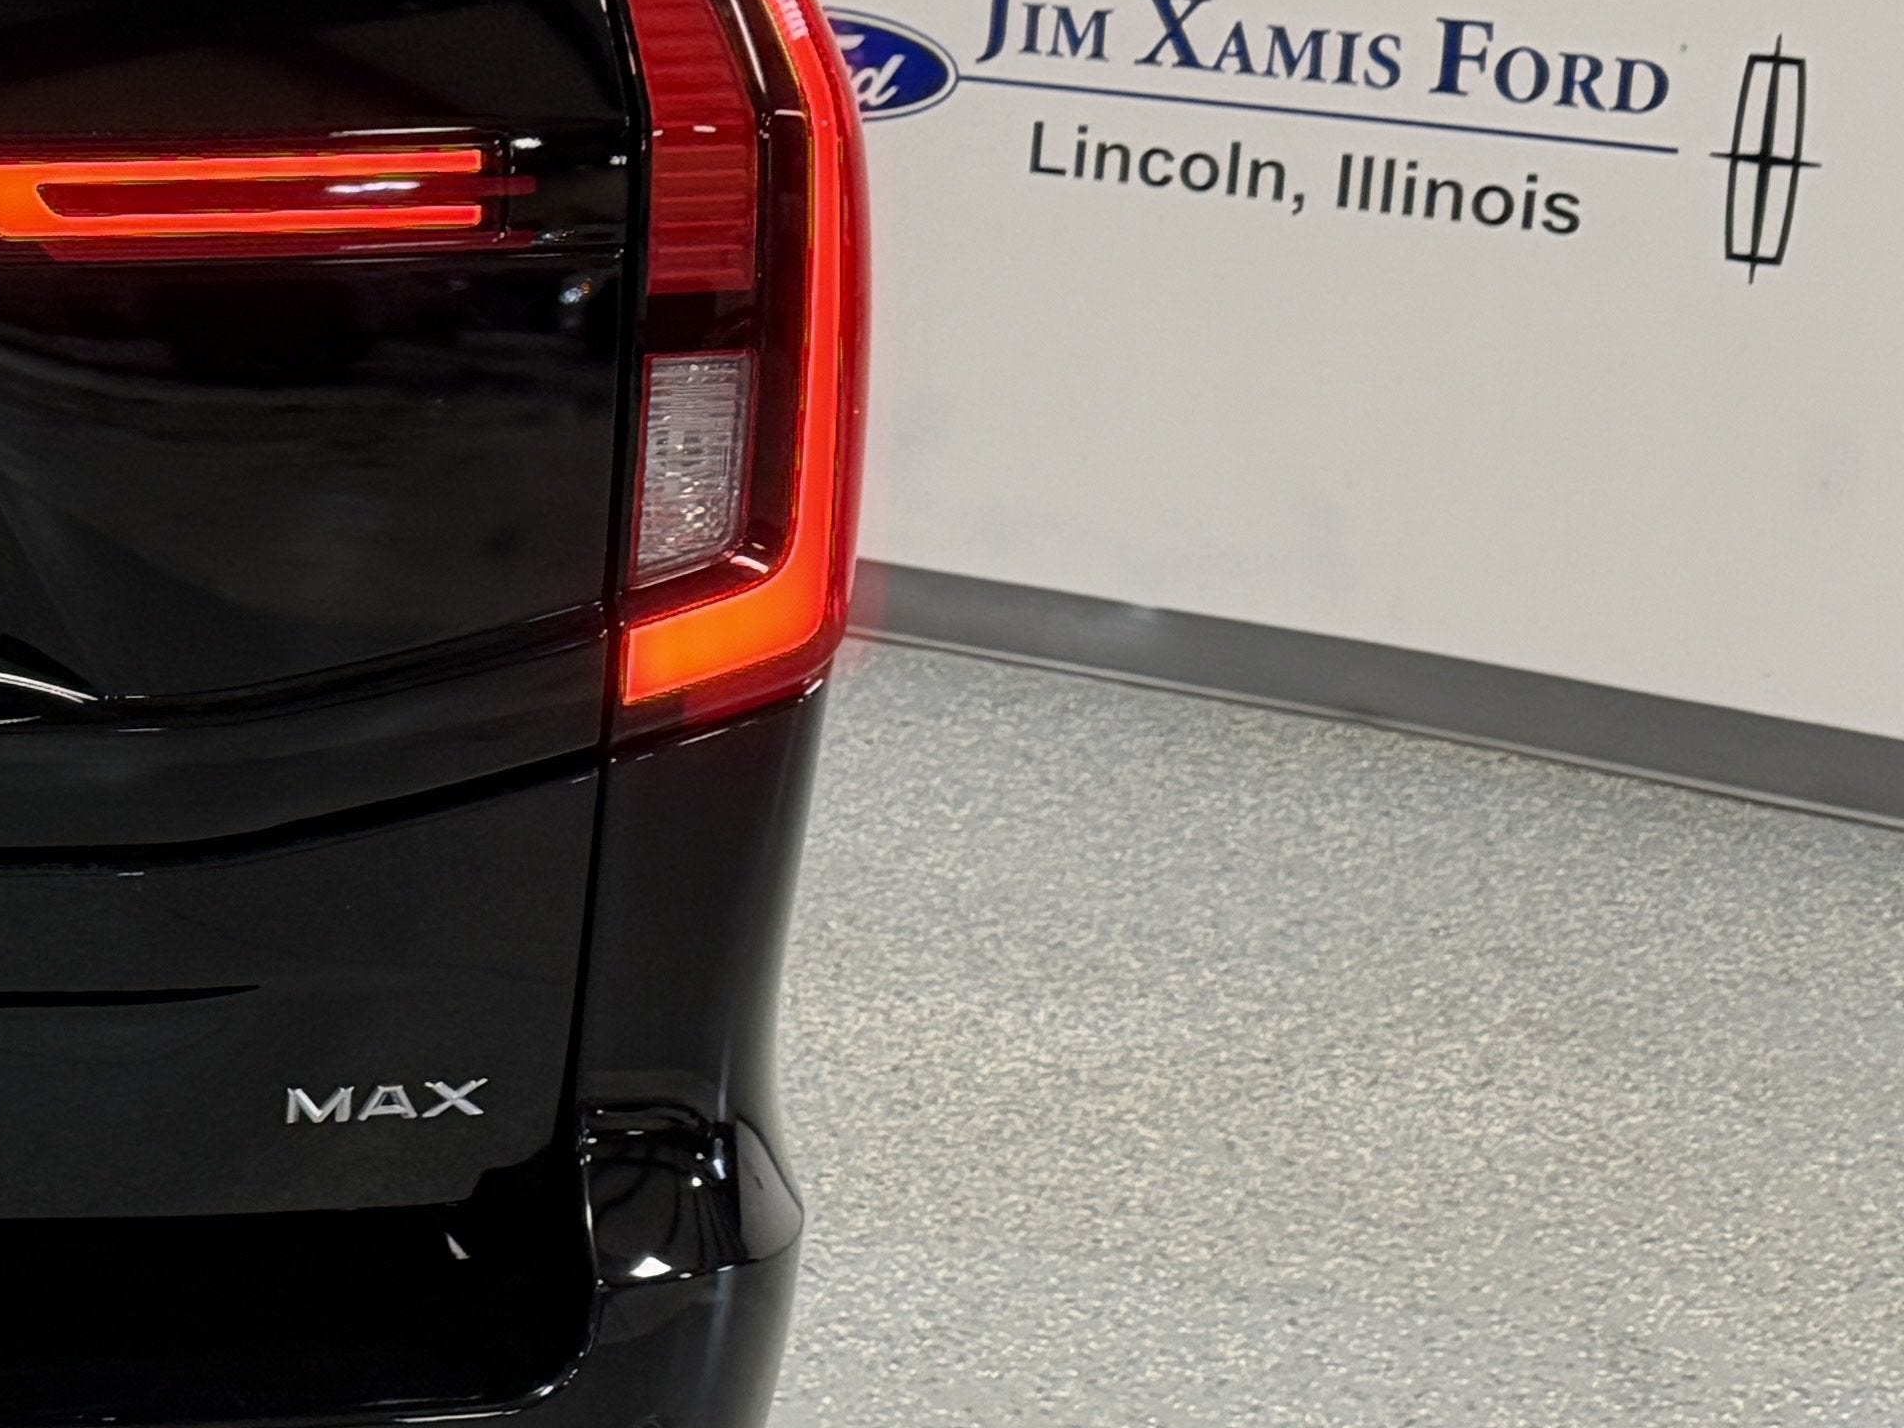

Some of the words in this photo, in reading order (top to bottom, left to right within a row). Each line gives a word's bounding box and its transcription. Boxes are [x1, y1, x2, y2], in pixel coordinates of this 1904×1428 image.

[1428, 16, 1670, 117] FORD
[1029, 121, 1306, 215] Lincoln,
[1335, 152, 1582, 235] Illinois
[286, 1077, 489, 1124] MAX
